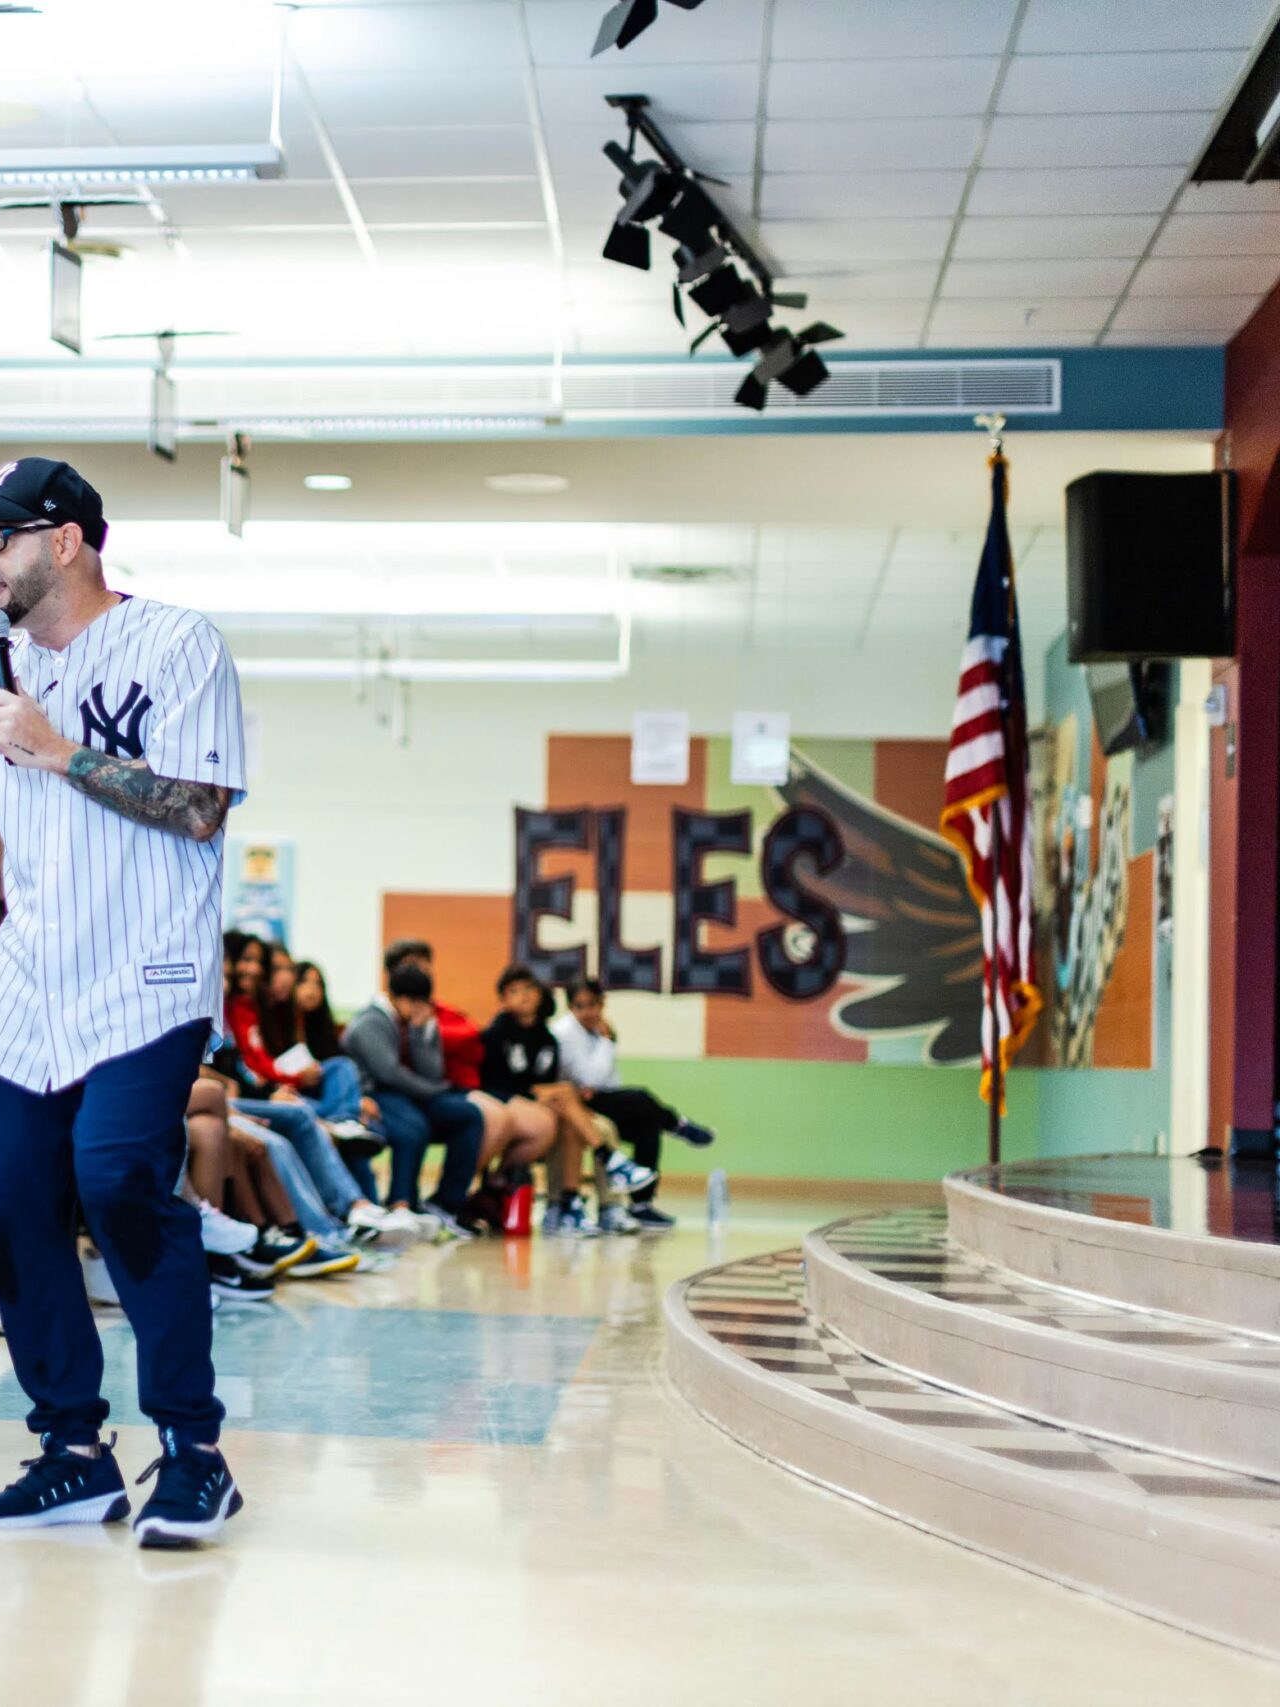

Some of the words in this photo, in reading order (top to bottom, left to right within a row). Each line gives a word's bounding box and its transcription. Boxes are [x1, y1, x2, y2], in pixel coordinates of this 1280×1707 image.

[79, 680, 153, 761] NY
[514, 805, 846, 1001] ELES
[160, 968, 190, 976] Majestic
